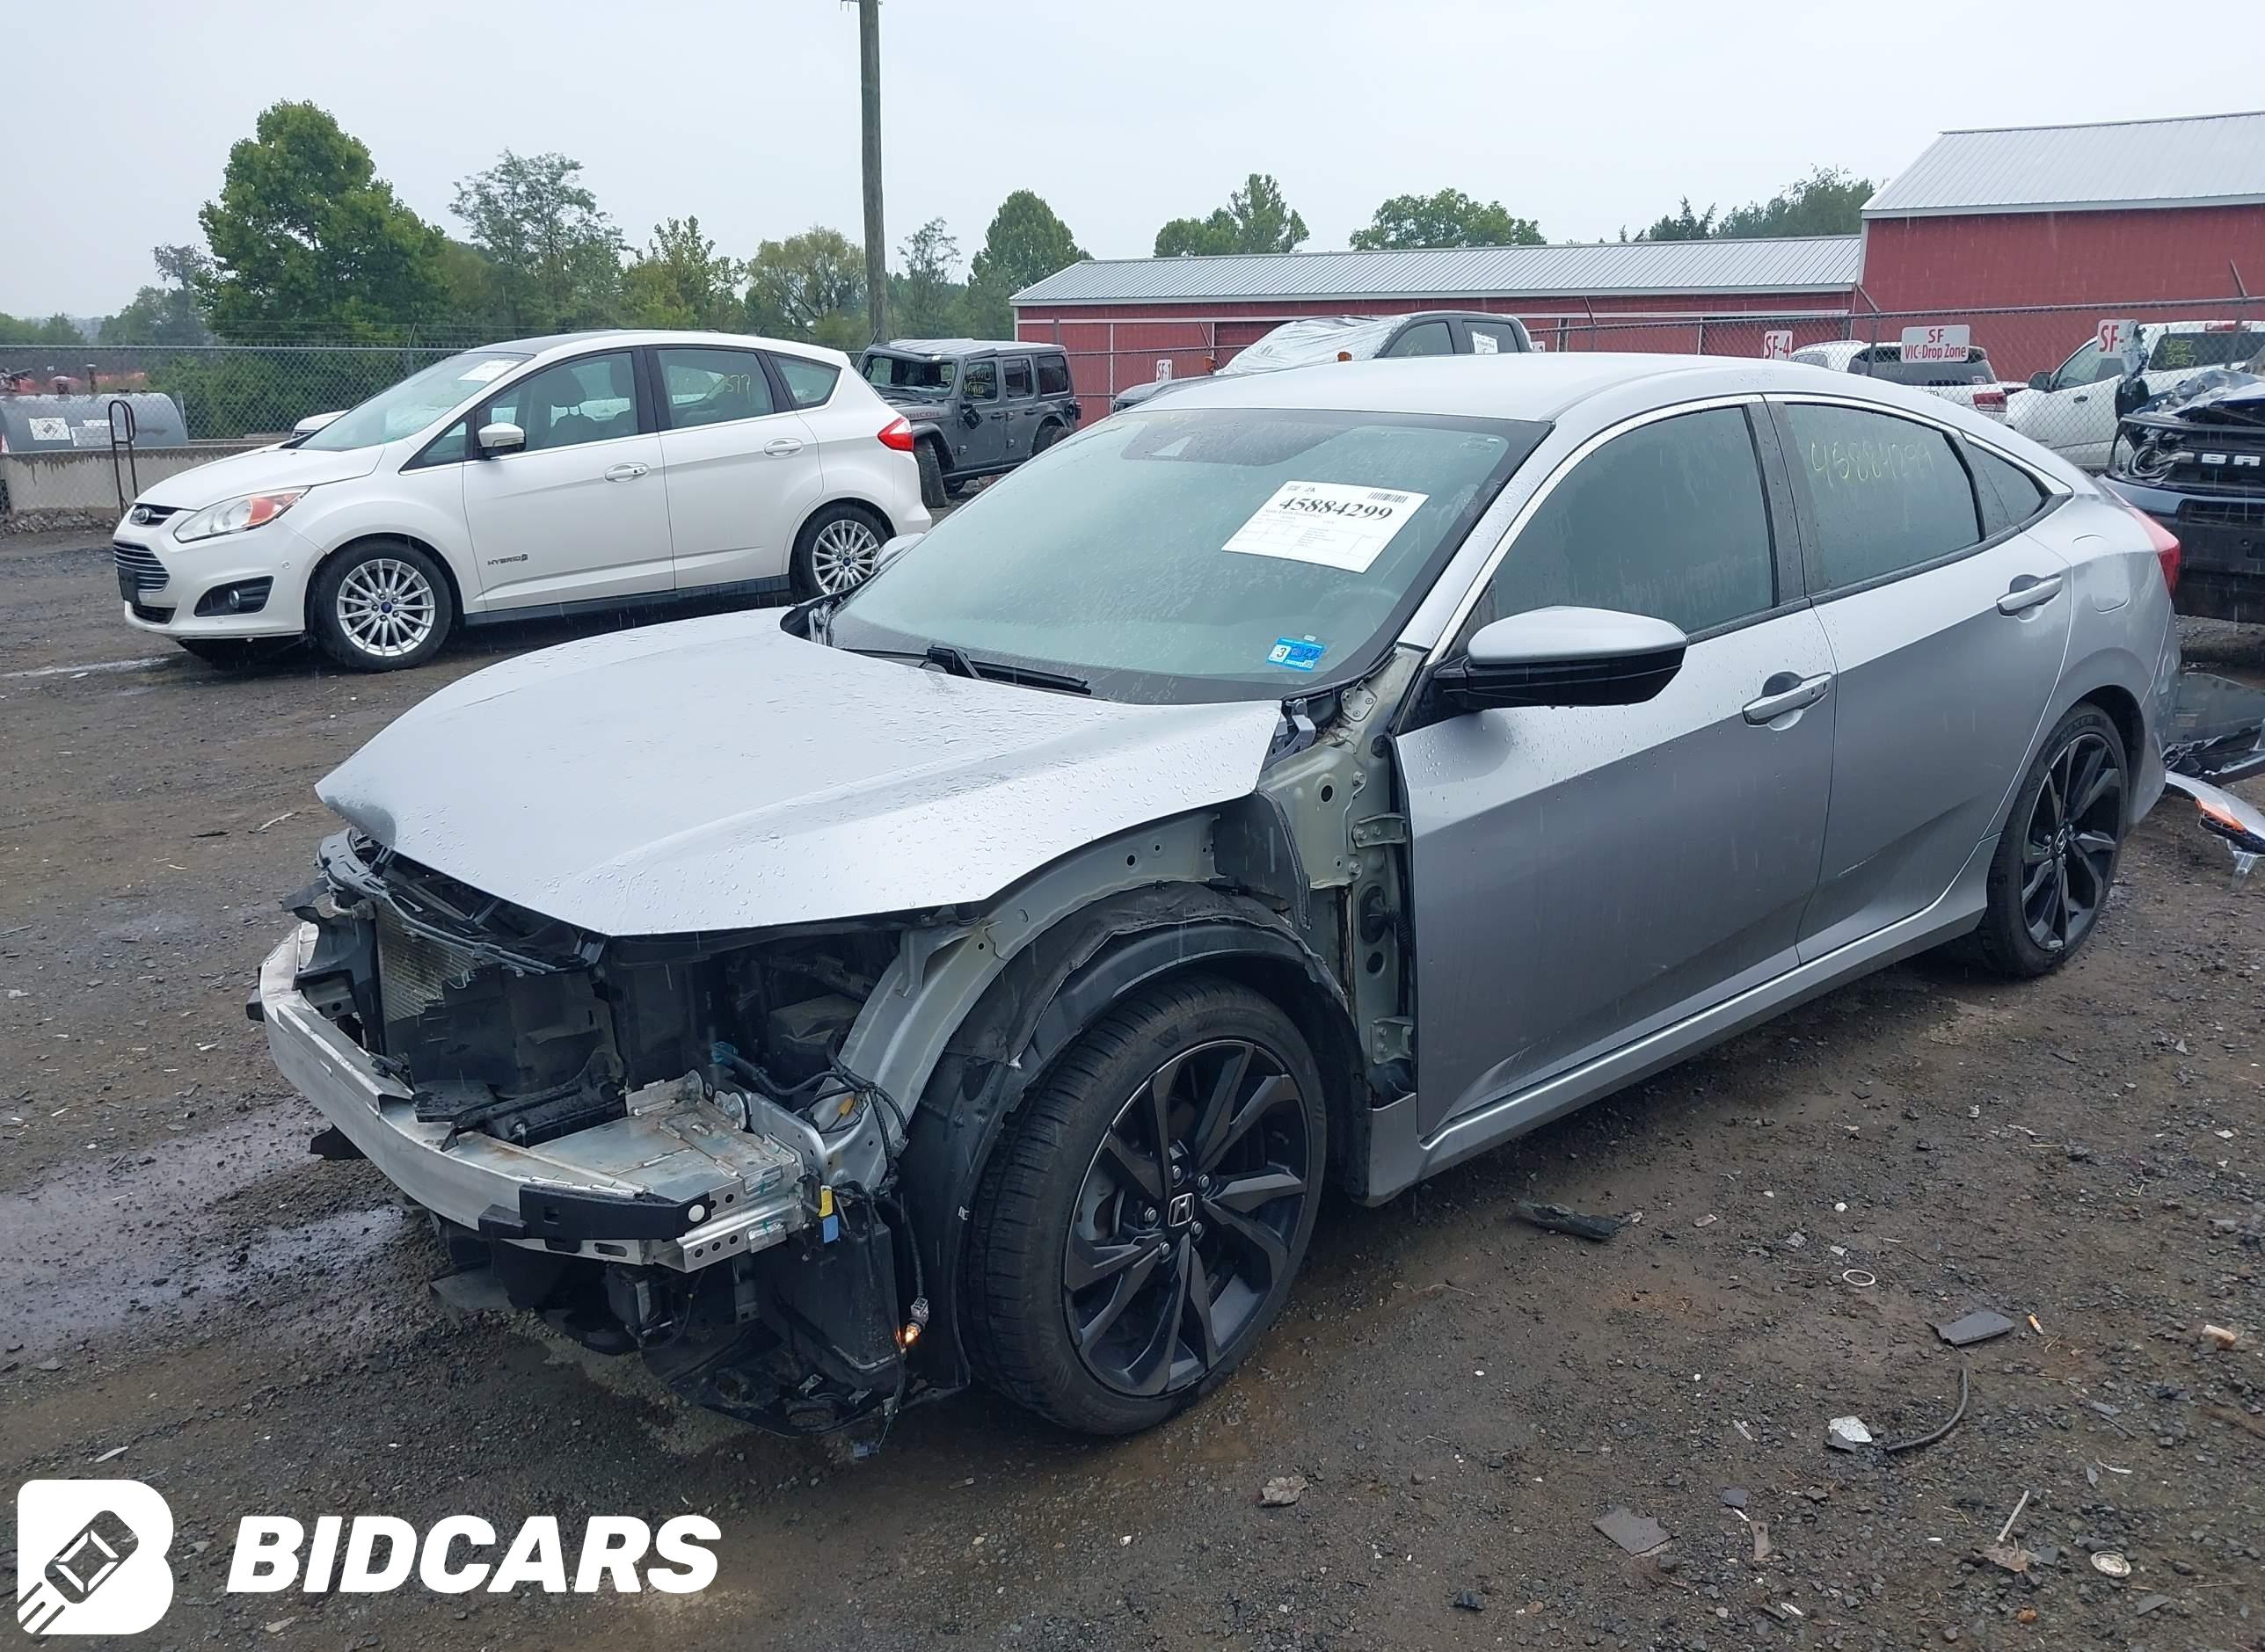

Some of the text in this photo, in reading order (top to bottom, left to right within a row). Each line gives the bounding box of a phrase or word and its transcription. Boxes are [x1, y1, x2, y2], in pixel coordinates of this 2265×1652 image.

[1928, 329, 1944, 343] SF
[2099, 324, 2124, 353] SF-
[1765, 335, 1790, 359] SF-4
[1904, 343, 1966, 360] VIC-Drop Zone
[1157, 363, 1171, 381] SF-1
[1279, 497, 1393, 520] 45884299
[1277, 647, 1286, 658] 3
